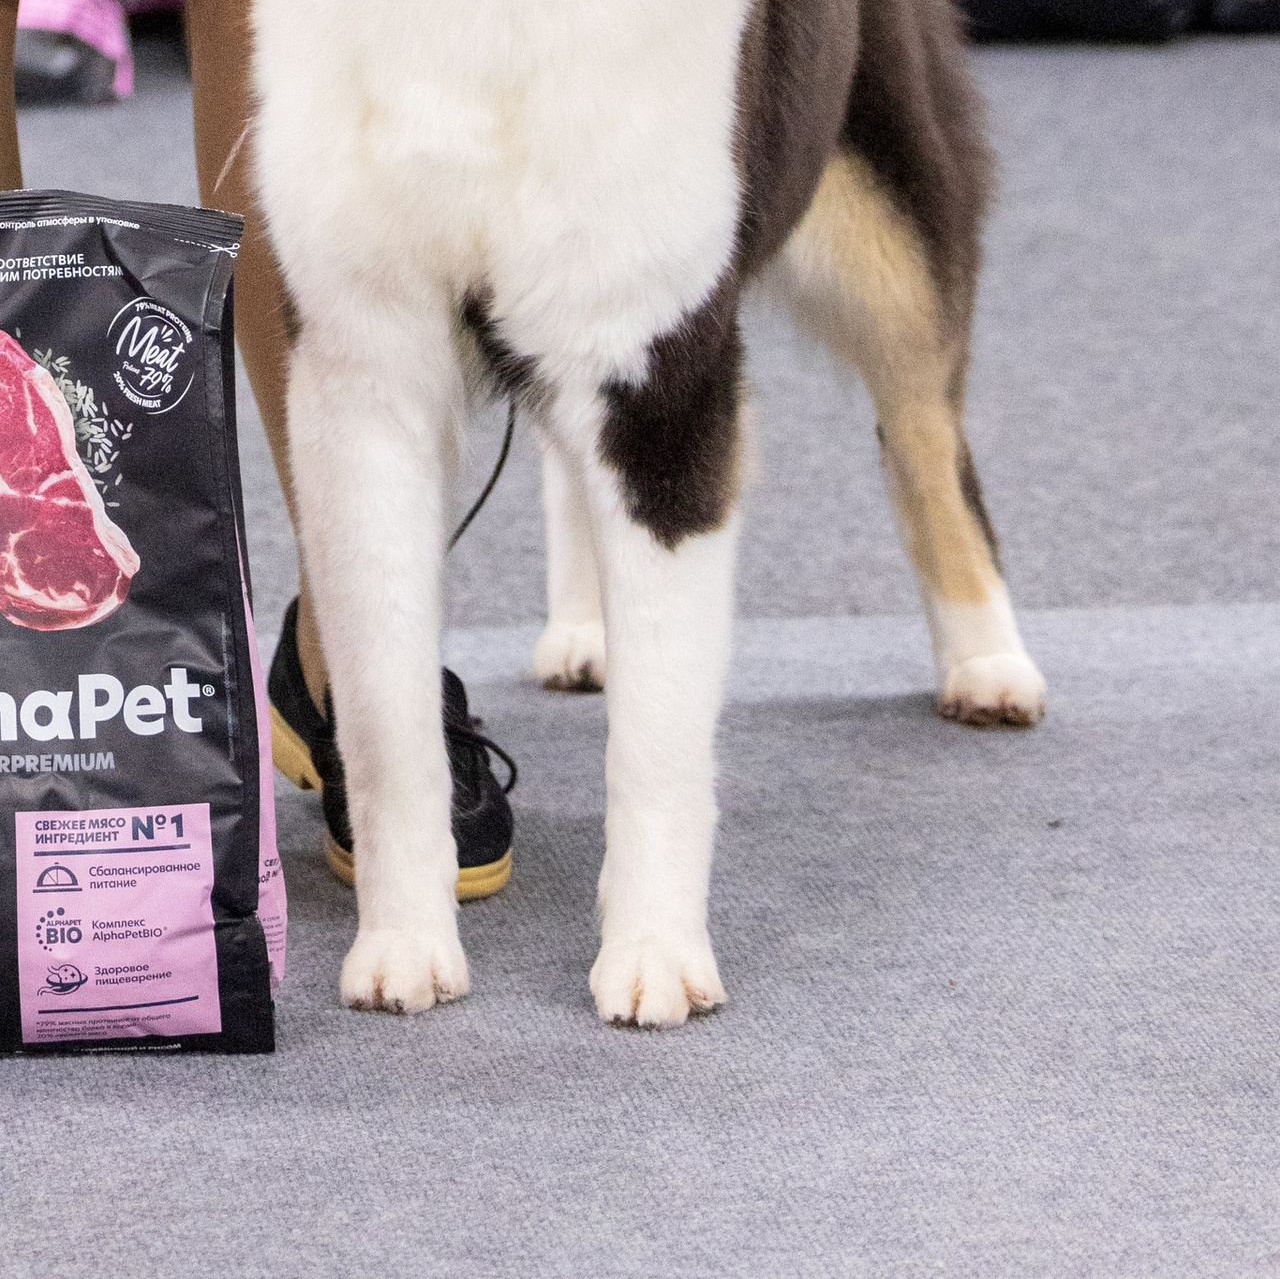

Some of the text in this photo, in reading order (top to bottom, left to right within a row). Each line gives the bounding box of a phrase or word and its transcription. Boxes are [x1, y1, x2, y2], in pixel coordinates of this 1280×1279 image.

[37, 216, 88, 228] атмосферы
[88, 216, 95, 224] в
[96, 216, 141, 230] упаковке
[116, 316, 186, 372] Meat
[140, 367, 173, 394] 79%
[35, 817, 126, 831] СВЕЖЕЕ МЯСО
[35, 831, 119, 845] ИНГРЕДИЕНТ
[89, 862, 201, 877] Сбалансированное
[90, 879, 137, 890] питание
[46, 919, 82, 927] ALPHAPET
[92, 919, 146, 930] Комплекс
[46, 926, 83, 944] BIO
[95, 964, 150, 976] Здоровое
[95, 971, 172, 986] пищеварение
